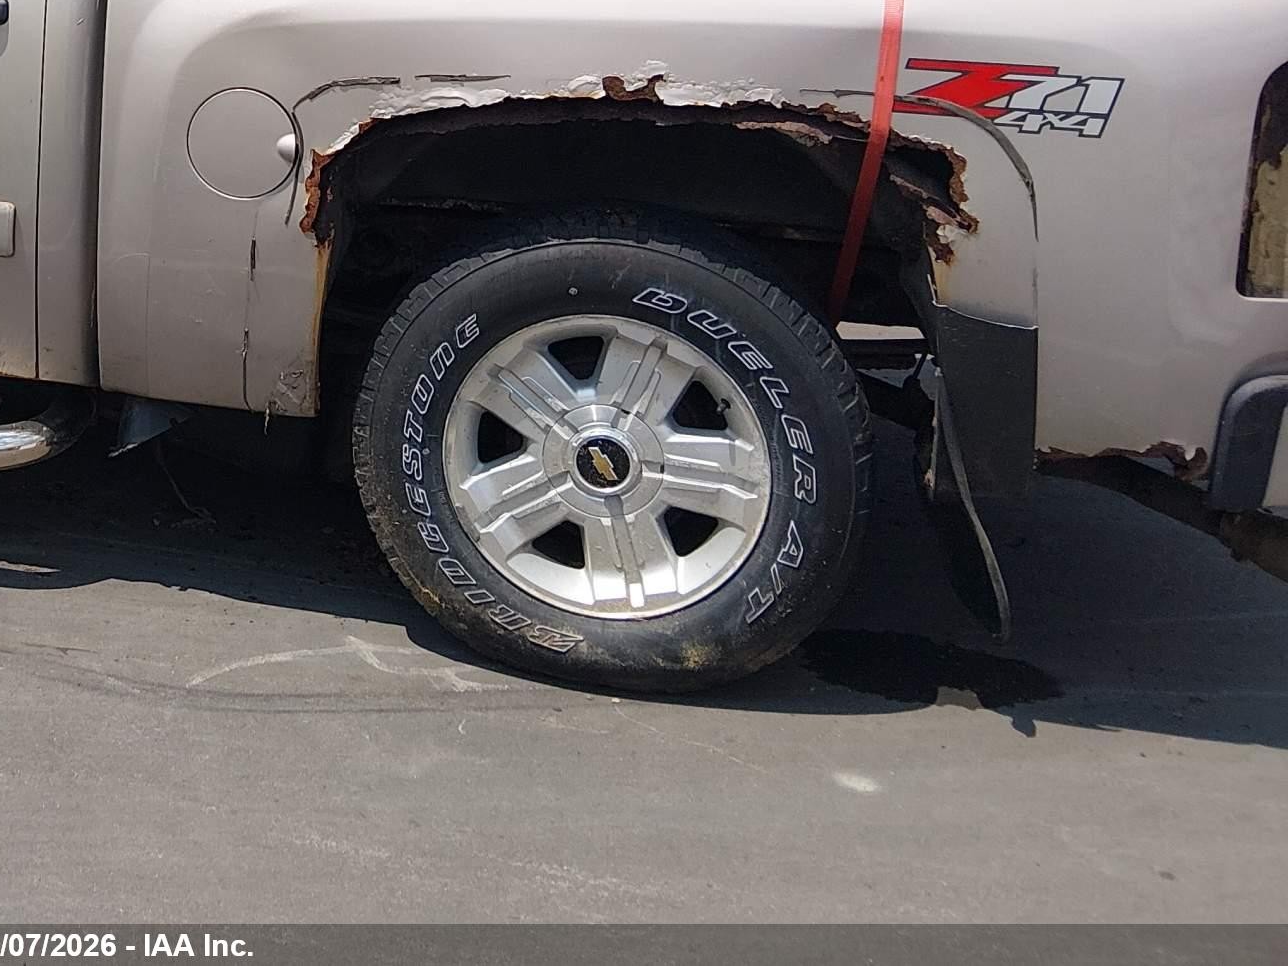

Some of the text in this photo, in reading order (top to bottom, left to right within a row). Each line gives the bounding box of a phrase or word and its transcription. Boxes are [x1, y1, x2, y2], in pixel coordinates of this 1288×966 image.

[892, 58, 1125, 118] Z71
[402, 314, 585, 654] BRIDGESTONE
[632, 287, 817, 504] DUELER
